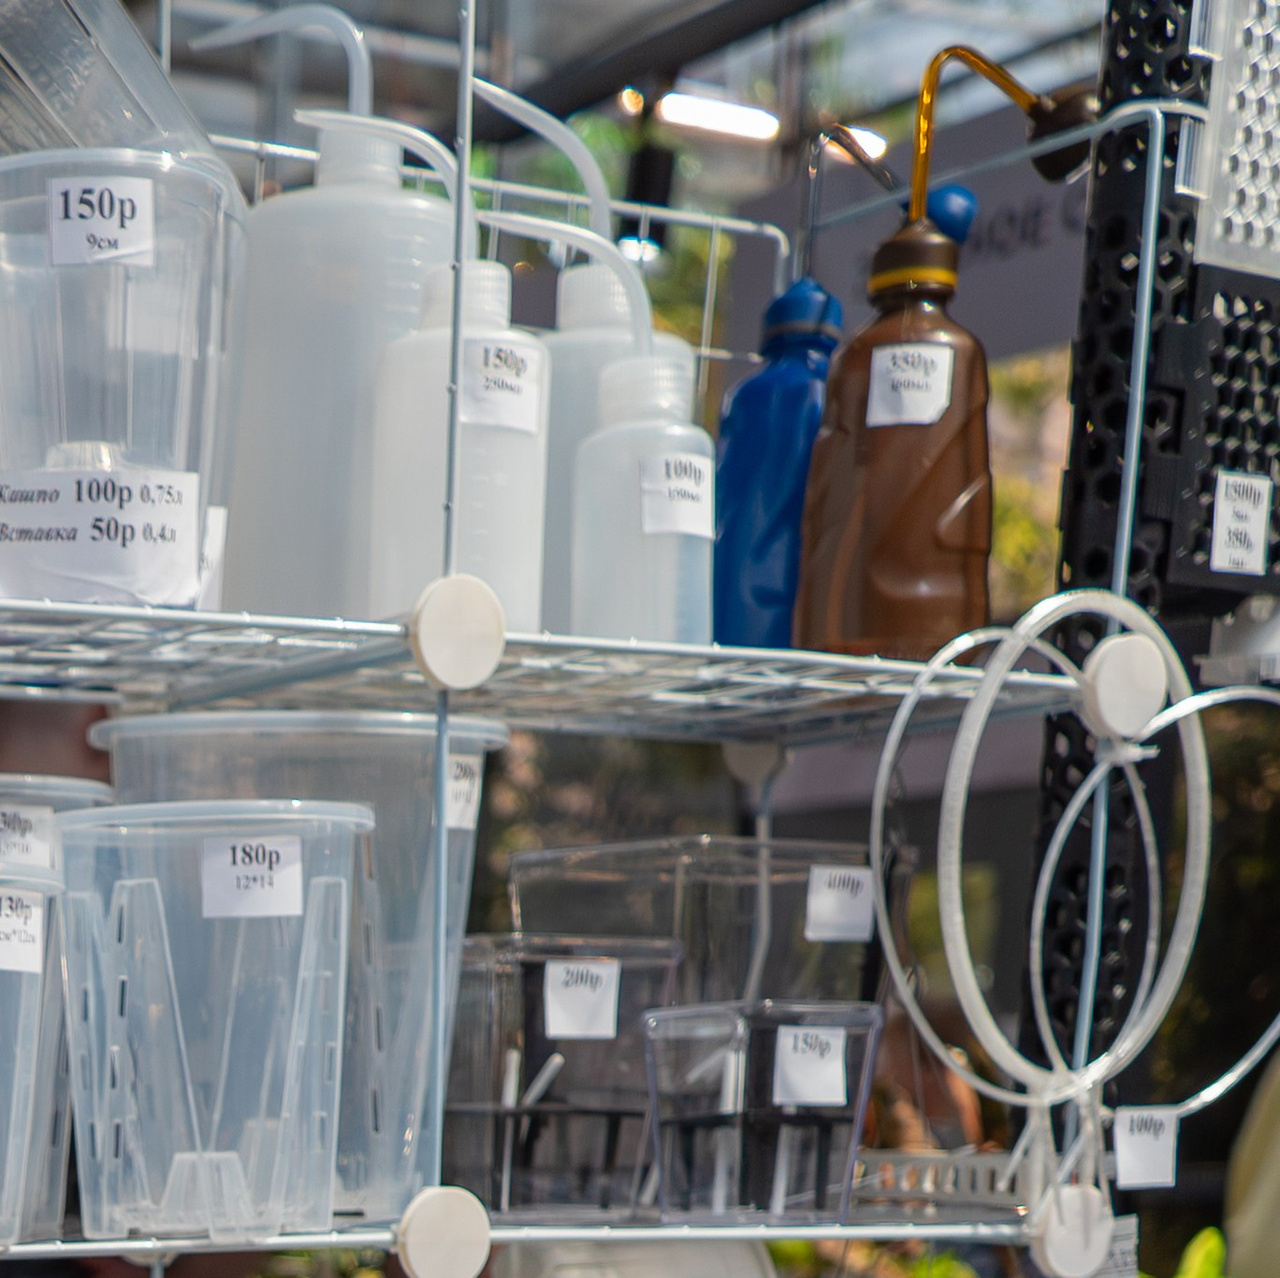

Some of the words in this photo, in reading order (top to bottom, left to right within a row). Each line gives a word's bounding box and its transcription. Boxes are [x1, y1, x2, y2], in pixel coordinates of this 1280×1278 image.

[60, 187, 138, 228] 150р
[86, 234, 120, 251] 9см
[75, 478, 132, 510] 100р
[91, 517, 135, 548] 50р
[230, 844, 281, 872] 180р
